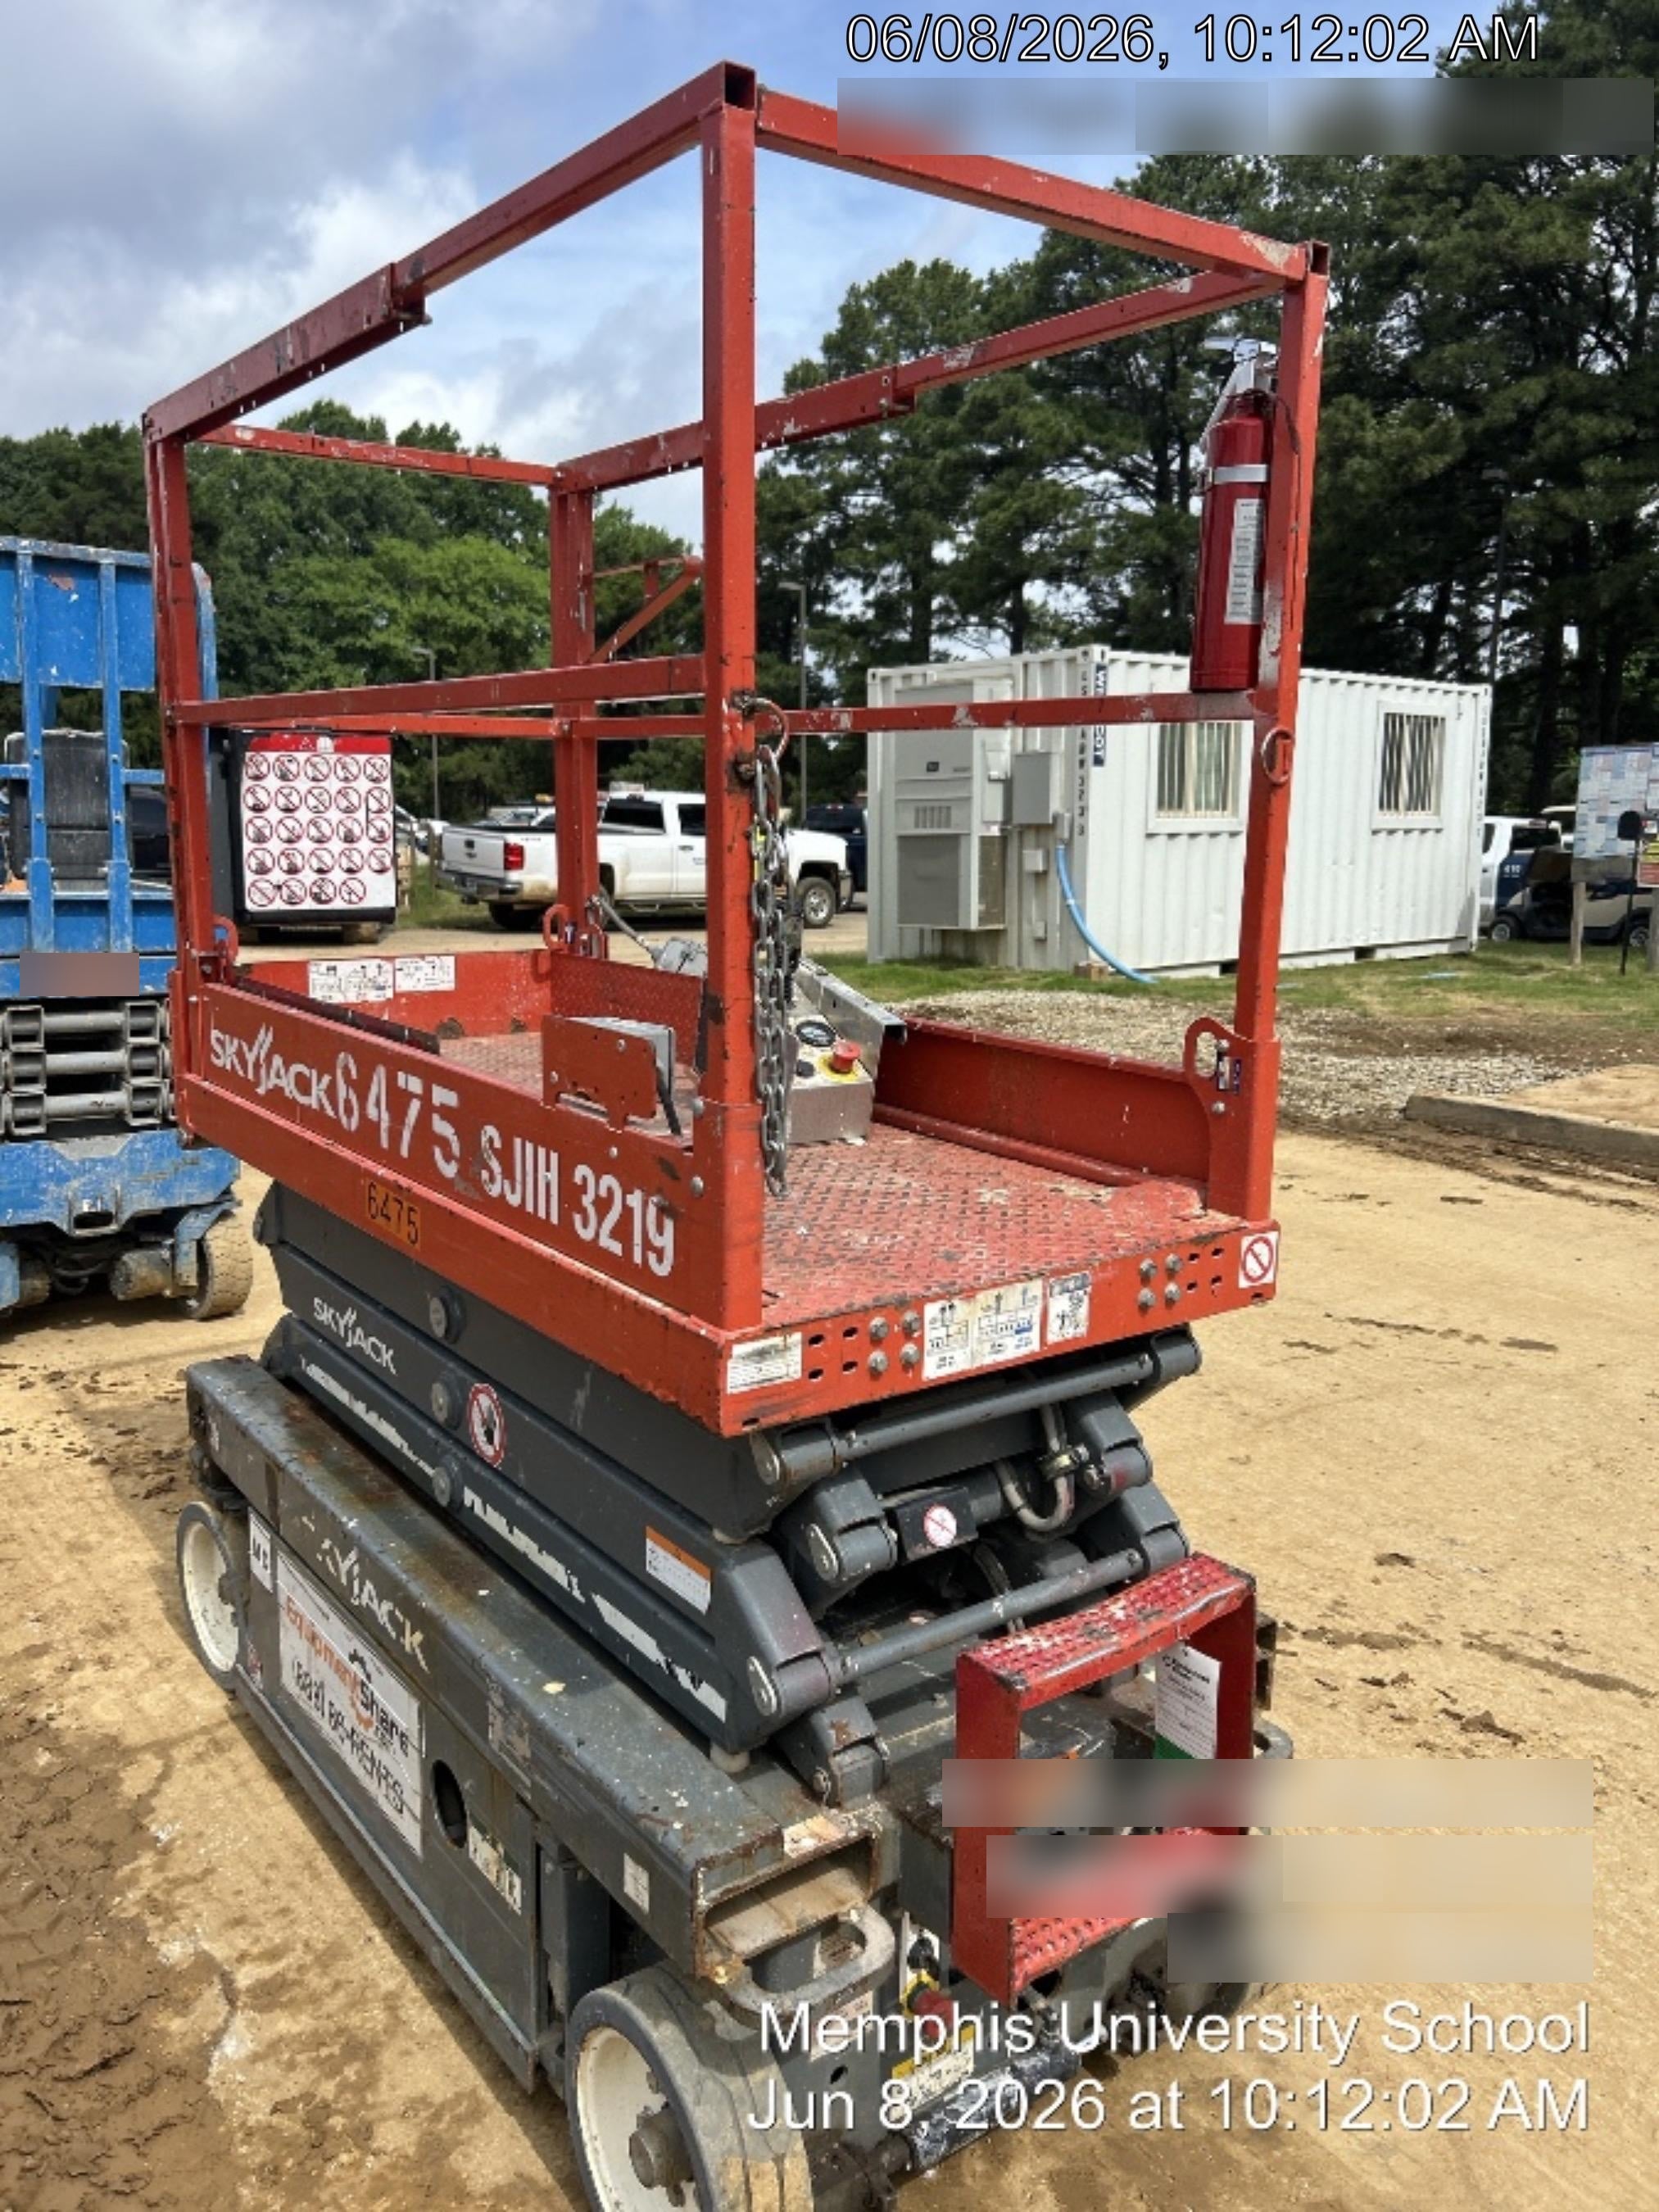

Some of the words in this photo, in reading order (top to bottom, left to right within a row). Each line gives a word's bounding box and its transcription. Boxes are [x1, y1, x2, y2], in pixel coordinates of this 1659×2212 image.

[211, 1022, 337, 1119] SKYJACK
[337, 1051, 460, 1178] 6475
[369, 1181, 419, 1245] 6475
[573, 1164, 674, 1276] 3219
[313, 1297, 397, 1376] SKYJACK
[301, 1514, 431, 1674] YJACK
